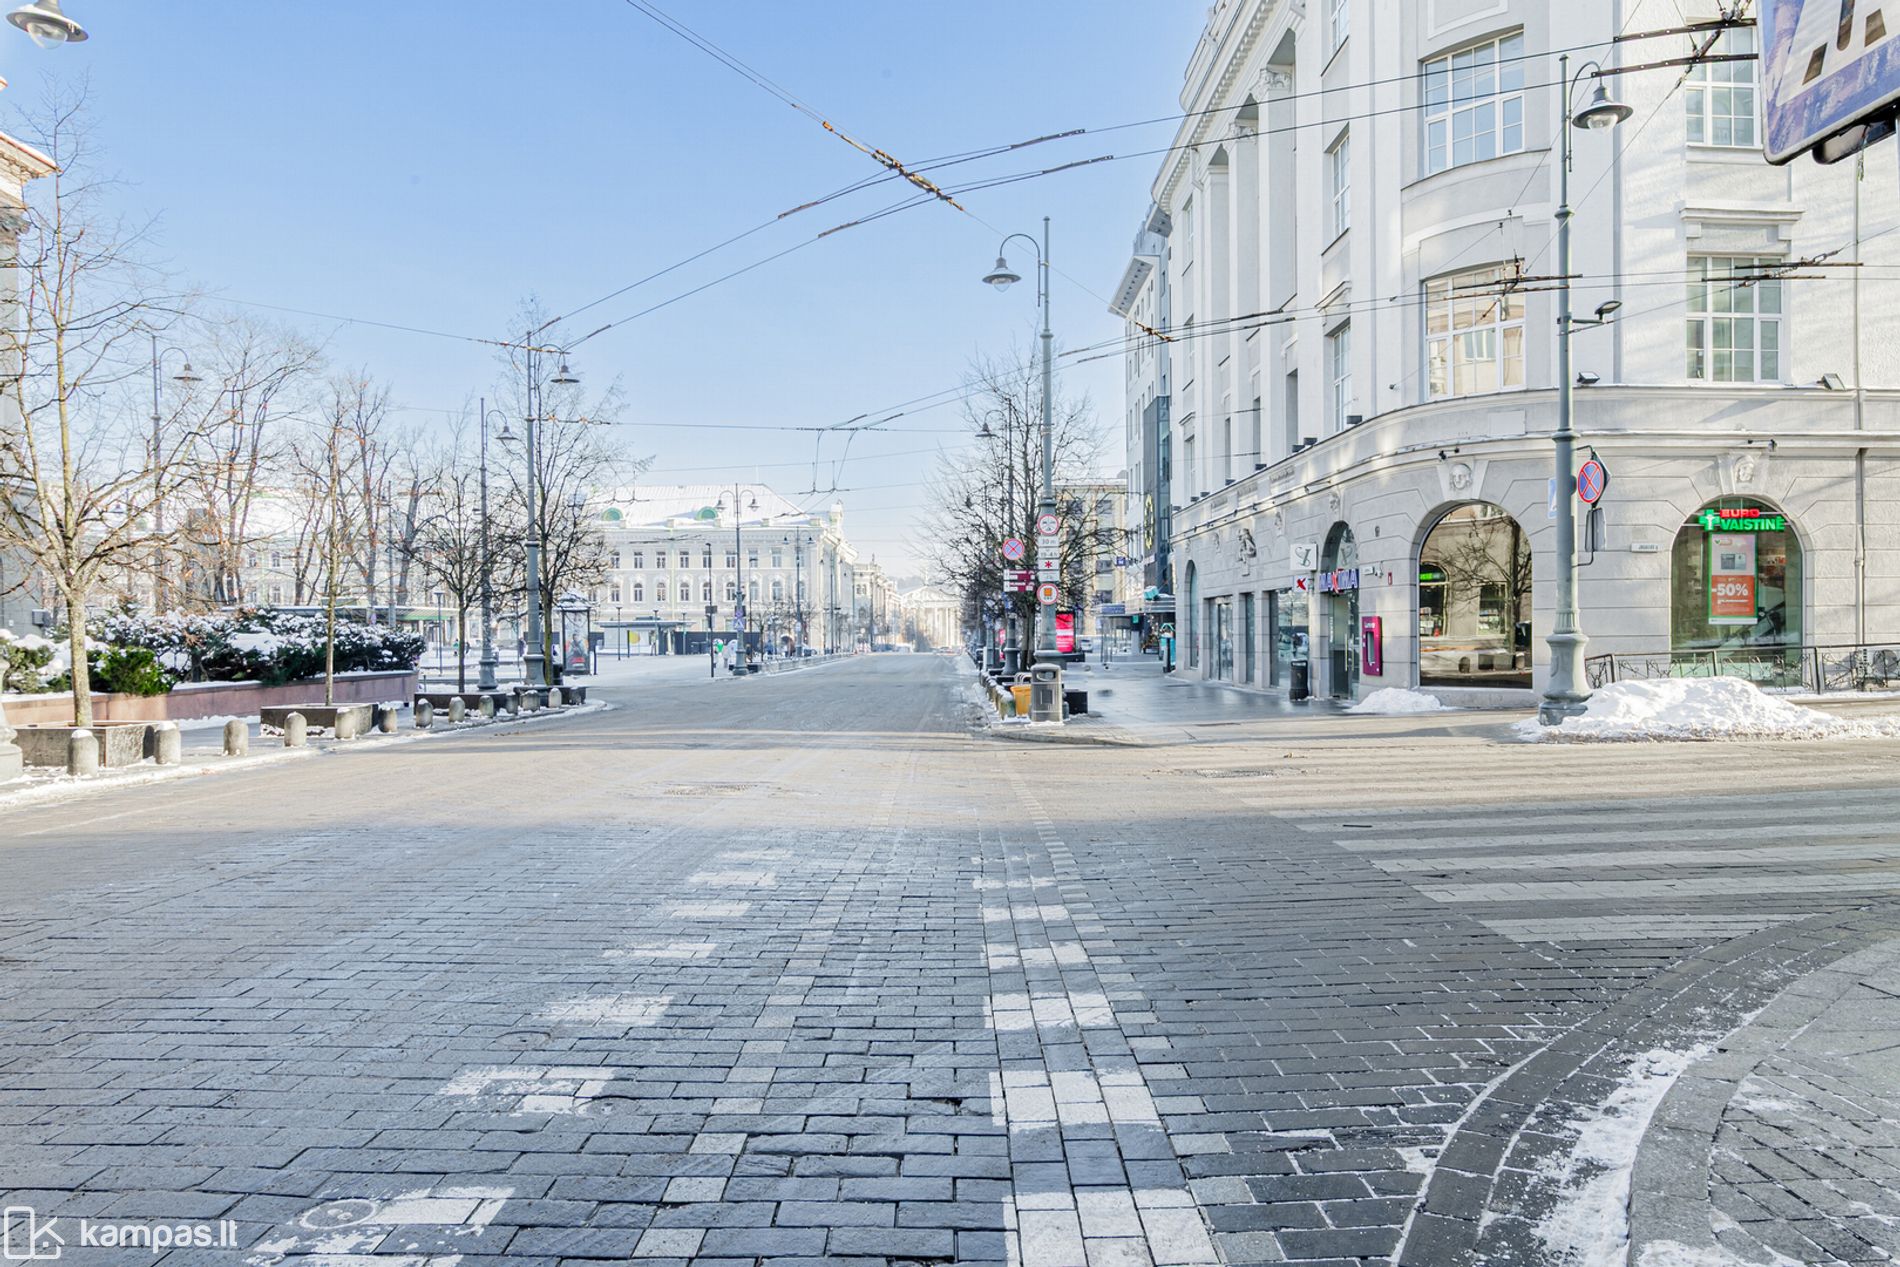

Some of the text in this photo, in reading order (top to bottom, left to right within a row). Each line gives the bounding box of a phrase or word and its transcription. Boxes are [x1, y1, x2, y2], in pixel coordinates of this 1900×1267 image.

[1720, 508, 1760, 518] EURO
[1720, 516, 1785, 531] VAISTINĖ
[1712, 583, 1749, 597] -50%
